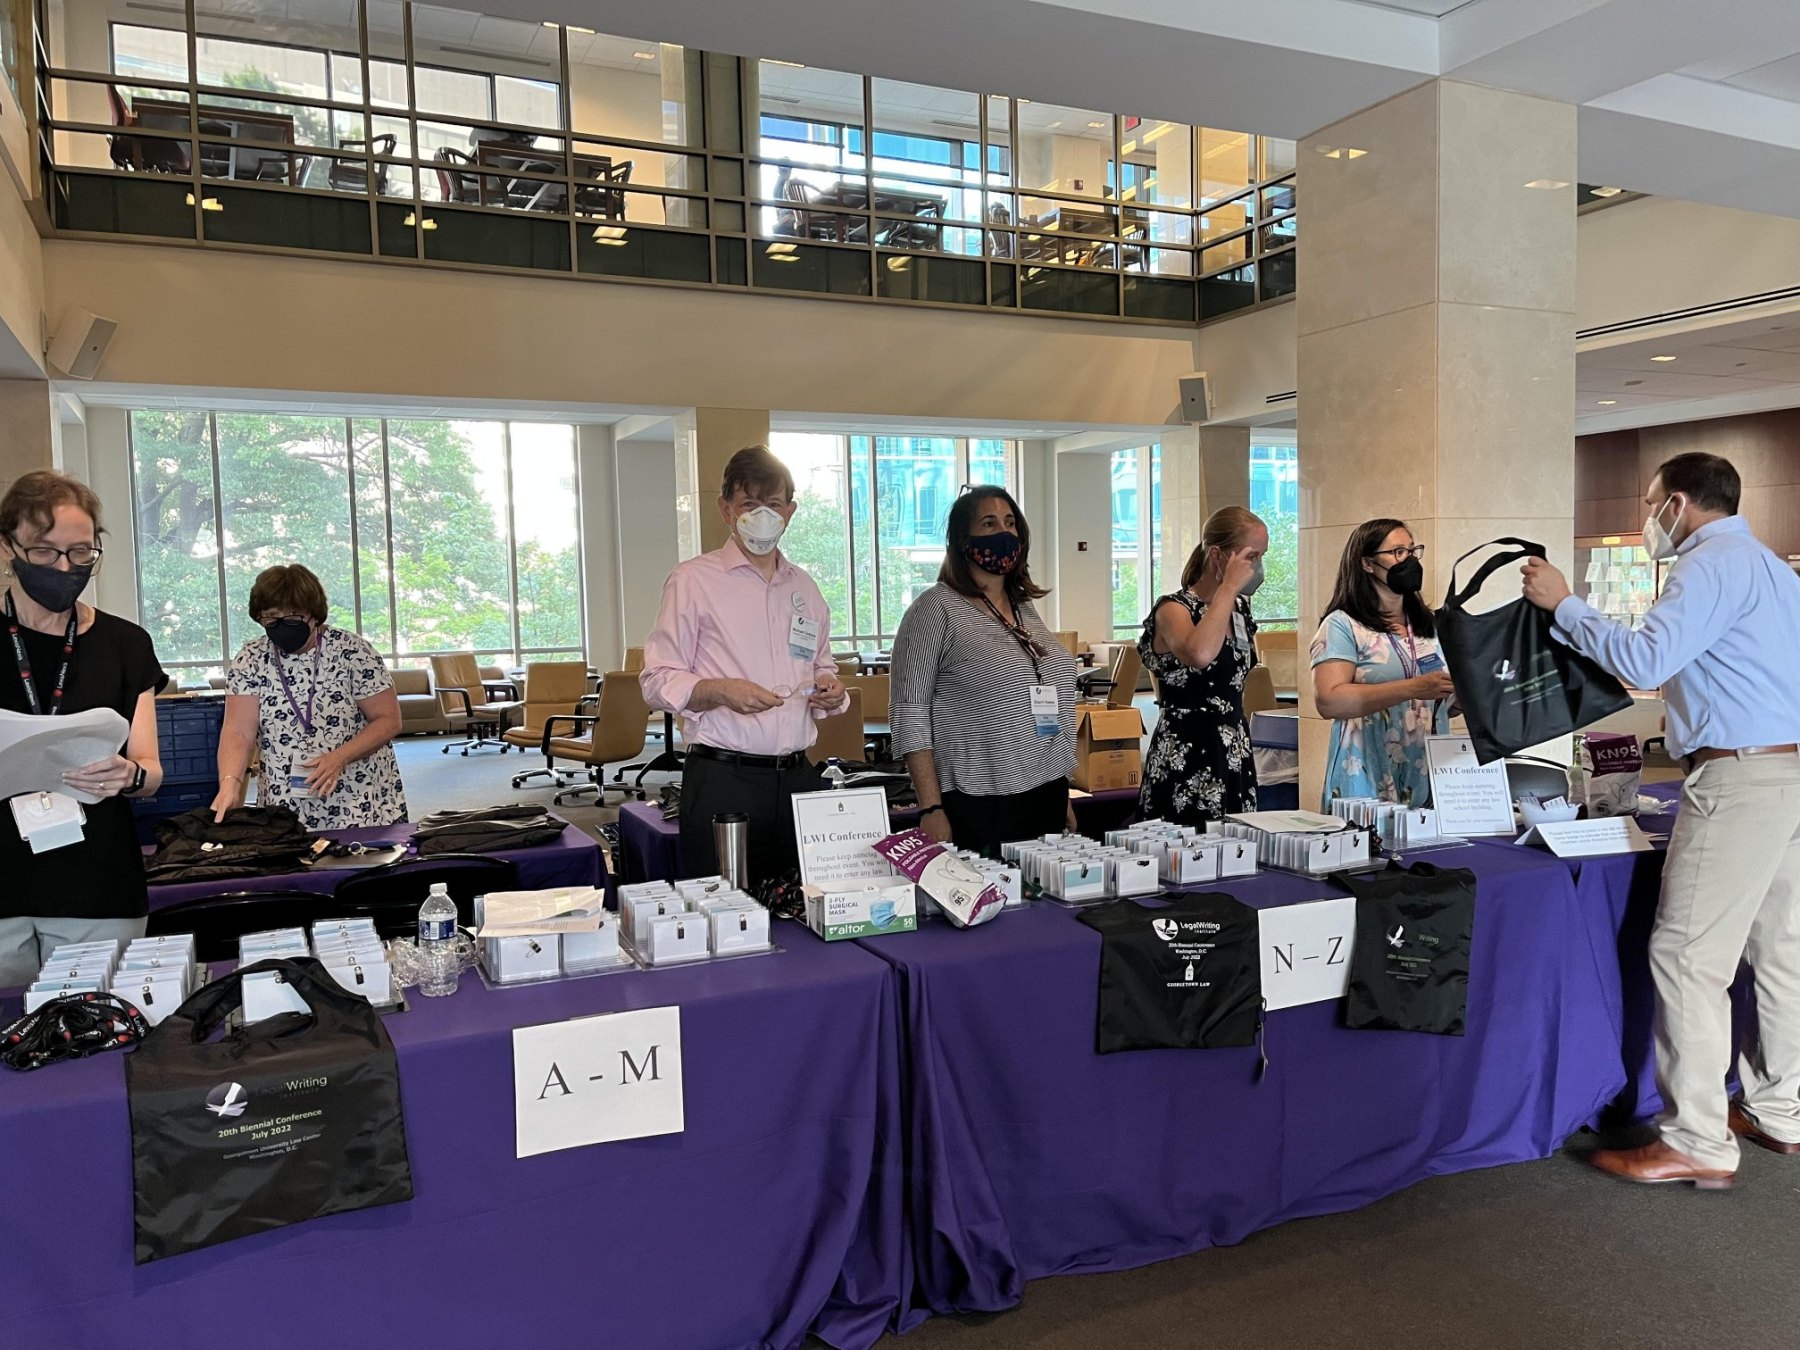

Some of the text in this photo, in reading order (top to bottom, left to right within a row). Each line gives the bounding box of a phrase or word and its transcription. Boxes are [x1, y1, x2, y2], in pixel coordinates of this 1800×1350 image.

[1596, 745, 1639, 760] KN95
[804, 831, 882, 845] LWI Conference
[886, 836, 923, 861] KN95
[816, 854, 836, 863] Please
[808, 864, 841, 873] throughout
[955, 896, 965, 906] 95
[838, 917, 913, 935] altor 50
[1180, 921, 1221, 931] LegalWriting
[1272, 944, 1295, 974] N
[1326, 936, 1345, 965] Z
[536, 1062, 574, 1101] A
[618, 1044, 663, 1086] M
[286, 1076, 328, 1091] Writing
[218, 1109, 323, 1138] 20th Biennial Conference
[251, 1125, 292, 1140] July 2022
[223, 1133, 322, 1159] Georgetown University Law Center
[249, 1148, 286, 1160] Washington,
